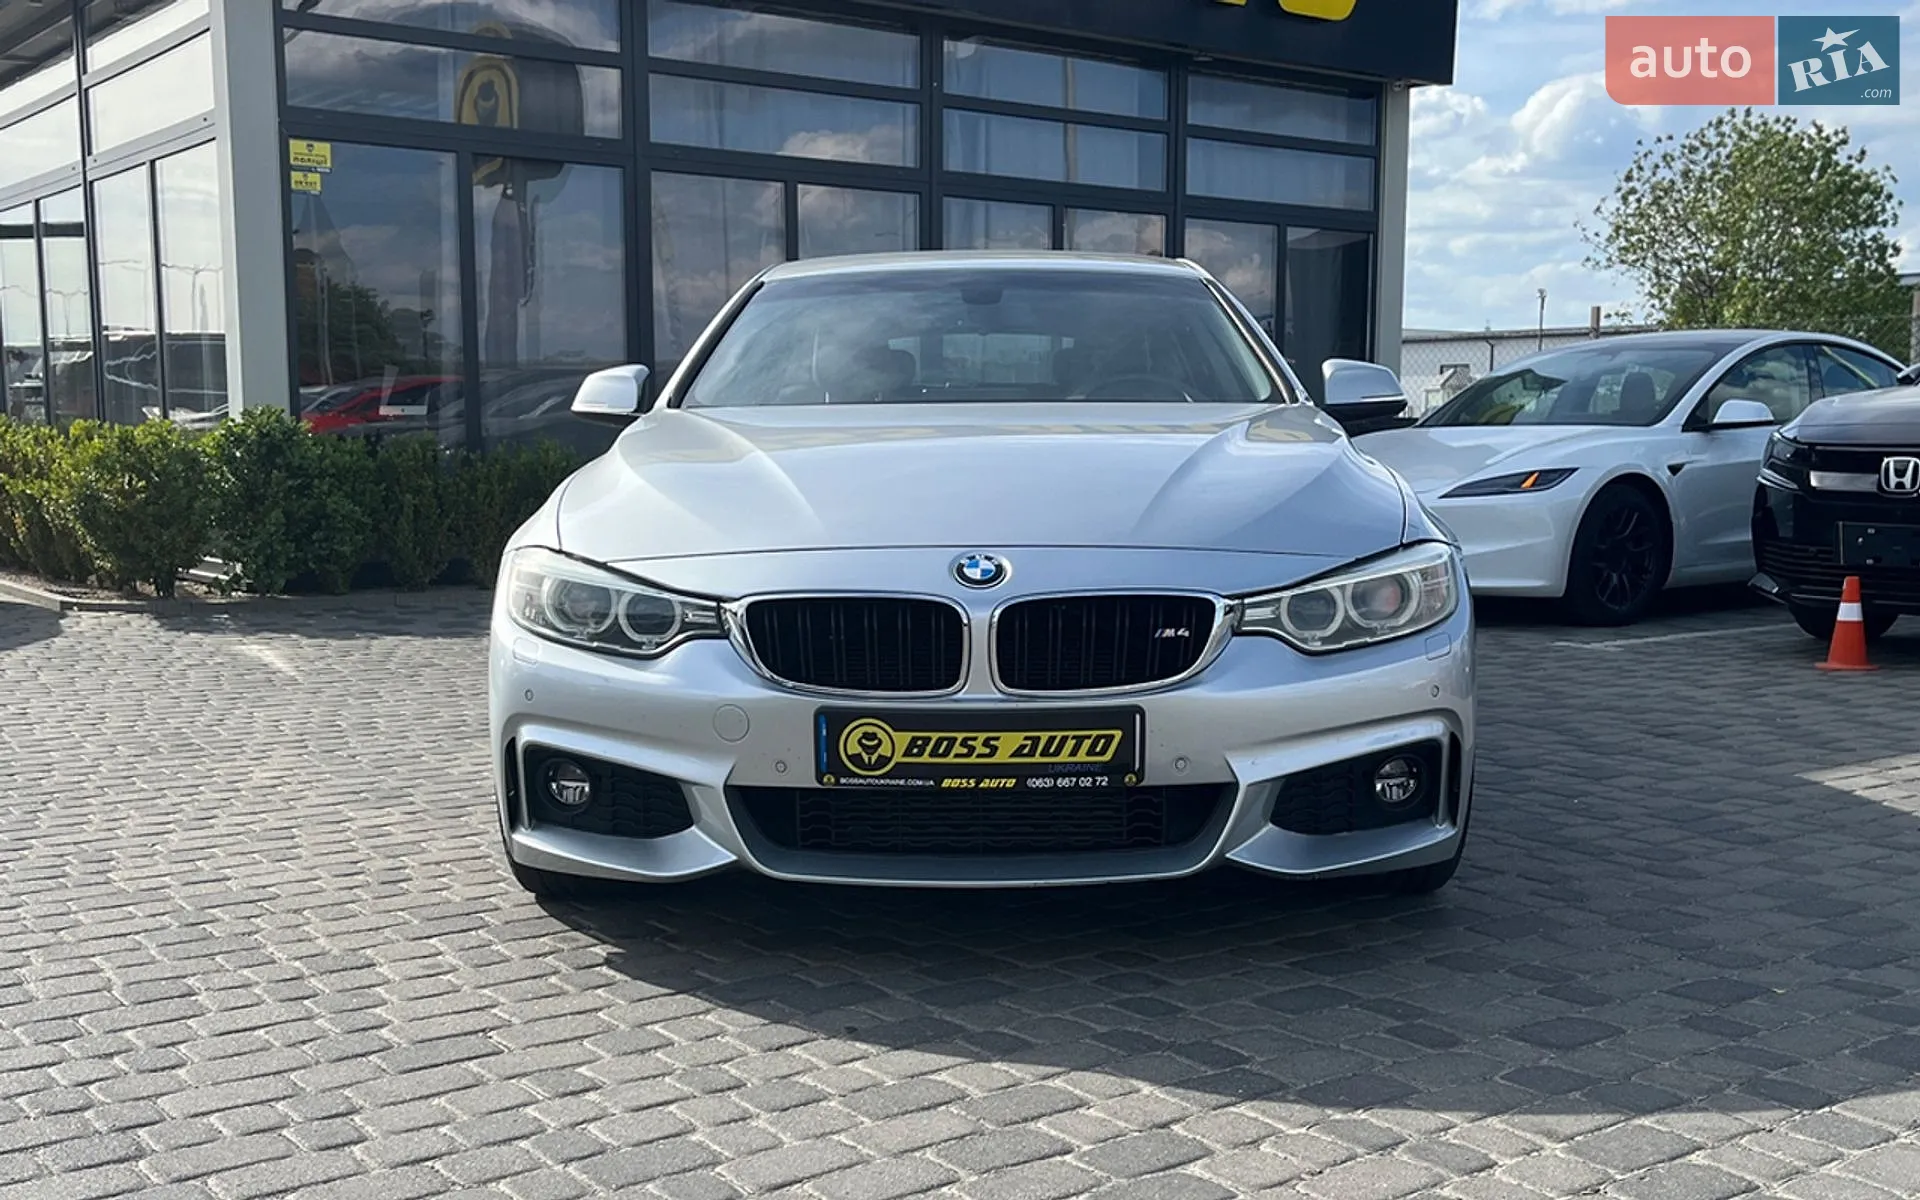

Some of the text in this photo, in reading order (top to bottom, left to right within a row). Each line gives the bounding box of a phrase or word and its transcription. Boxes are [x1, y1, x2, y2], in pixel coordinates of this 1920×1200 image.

[902, 733, 1115, 759] BOSS AUTO
[941, 778, 1017, 788] BOSS AUTO
[1026, 777, 1054, 788] (063)
[1078, 777, 1094, 787] 02
[1095, 776, 1109, 786] 72
